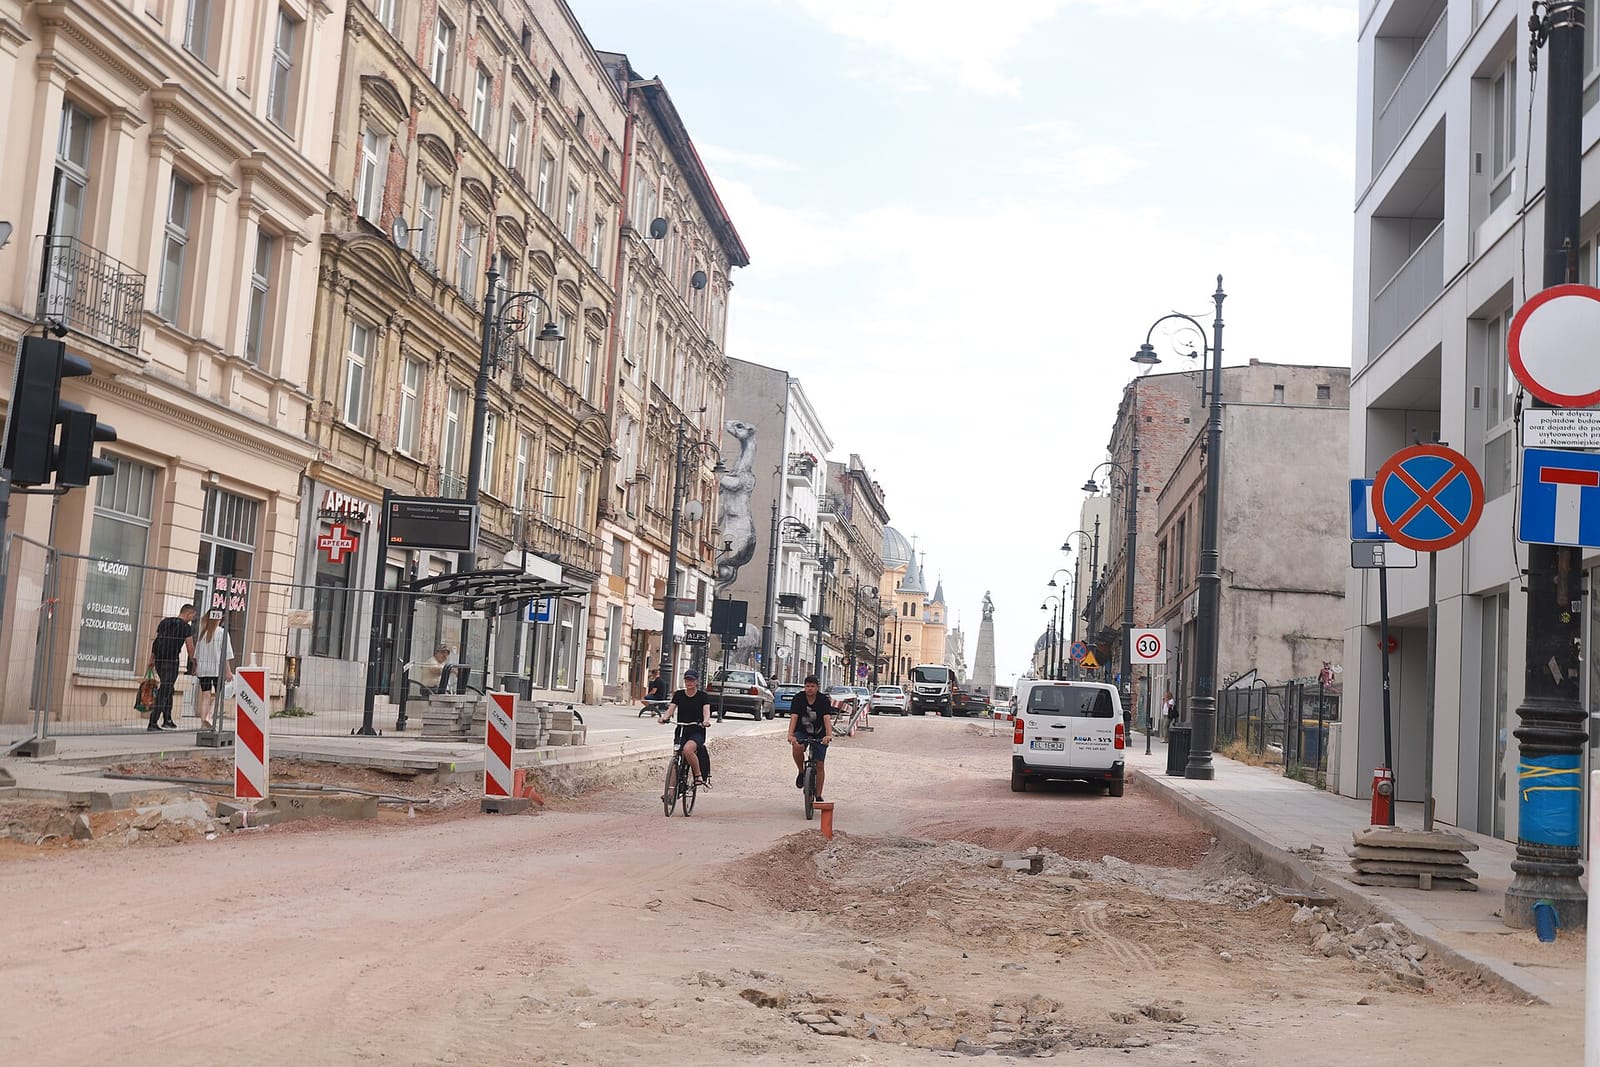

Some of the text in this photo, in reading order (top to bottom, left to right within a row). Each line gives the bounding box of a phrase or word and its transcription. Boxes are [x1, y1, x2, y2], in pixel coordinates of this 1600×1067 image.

[1566, 409, 1593, 418] dotyczy
[325, 490, 373, 524] APTEKA
[322, 539, 350, 547] APTEKA
[92, 602, 130, 616] REHABILITACJA
[1139, 640, 1157, 653] 30
